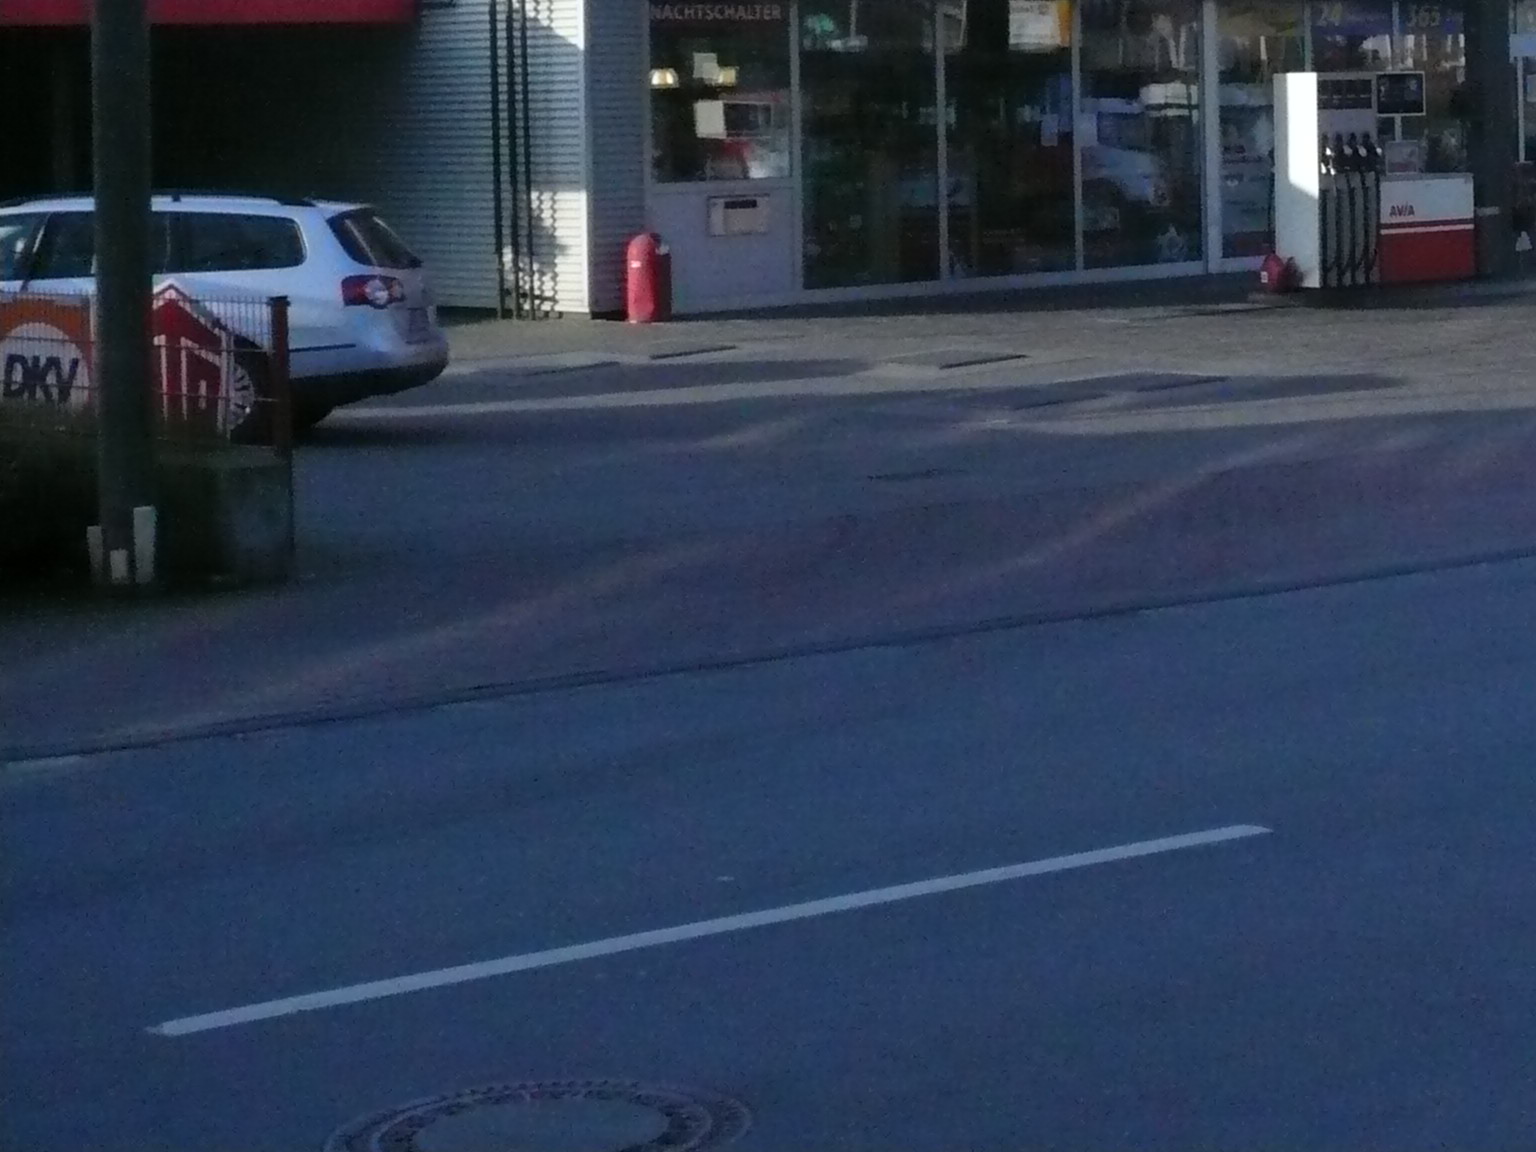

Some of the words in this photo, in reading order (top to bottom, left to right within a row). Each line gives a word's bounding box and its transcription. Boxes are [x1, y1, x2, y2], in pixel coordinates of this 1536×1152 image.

[651, 4, 782, 21] NACHTSCHALTER
[1389, 202, 1416, 218] AVIA
[2, 352, 79, 404] DKV
